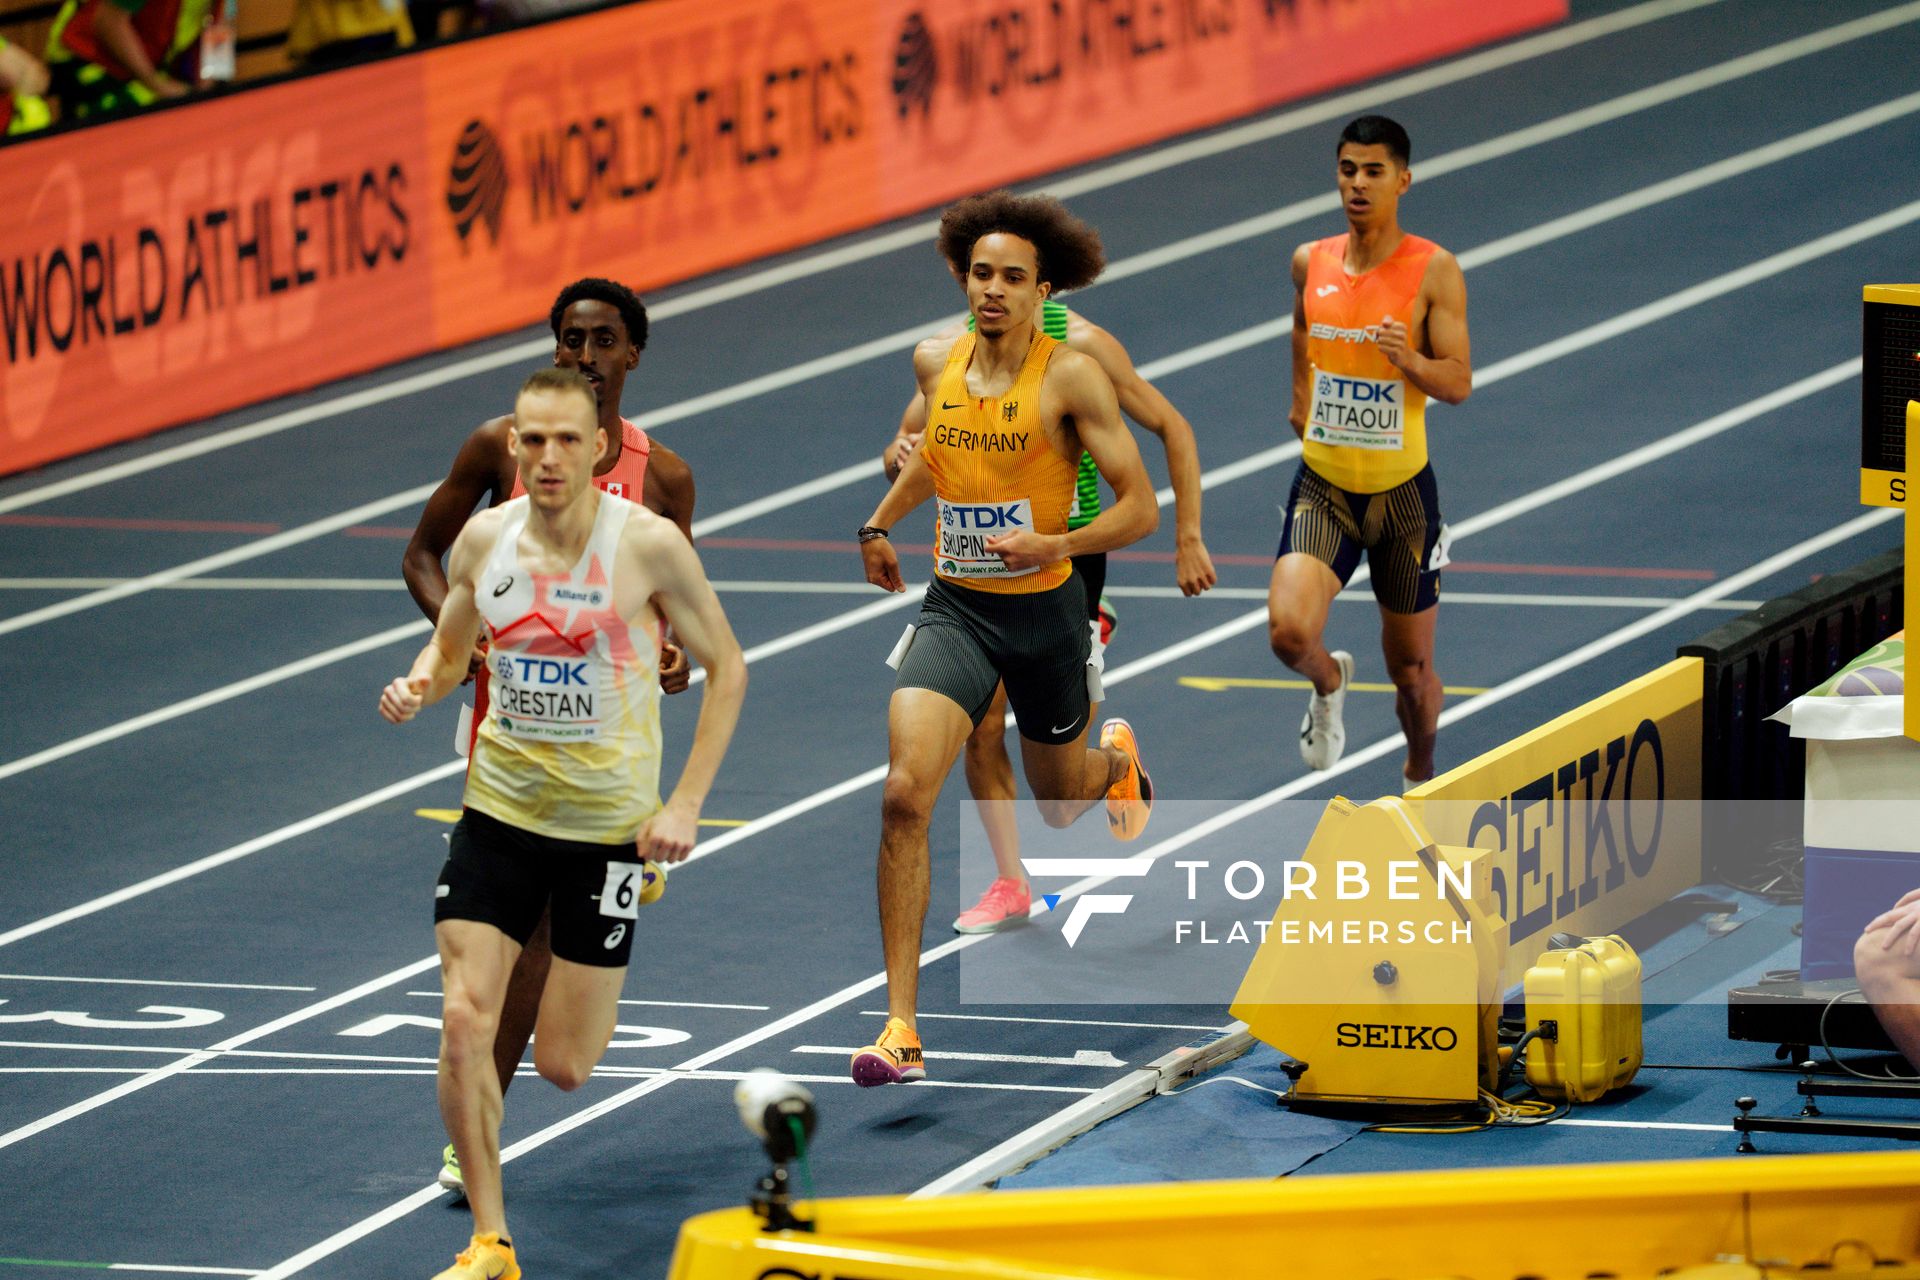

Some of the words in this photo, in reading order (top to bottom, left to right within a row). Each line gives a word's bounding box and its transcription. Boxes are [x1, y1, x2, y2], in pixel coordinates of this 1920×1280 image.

[523, 105, 663, 223] WORLD
[670, 52, 863, 188] ATHLETICS
[0, 228, 168, 364] WORLD
[180, 162, 411, 321] ATHLETICS
[1332, 377, 1396, 403] TDK
[1315, 400, 1398, 430] ATTAOUI
[935, 424, 1029, 452] GERMANY
[1890, 478, 1906, 502] S
[952, 503, 1024, 529] TDK
[943, 531, 996, 557] SKUPIN
[555, 589, 587, 601] Allianz
[515, 658, 589, 686] TDK
[501, 684, 593, 718] CRESTAN
[1467, 719, 1664, 946] SEIKO
[616, 872, 633, 909] 6
[1337, 1023, 1457, 1051] SEIKO
[900, 1047, 923, 1062] NITR
